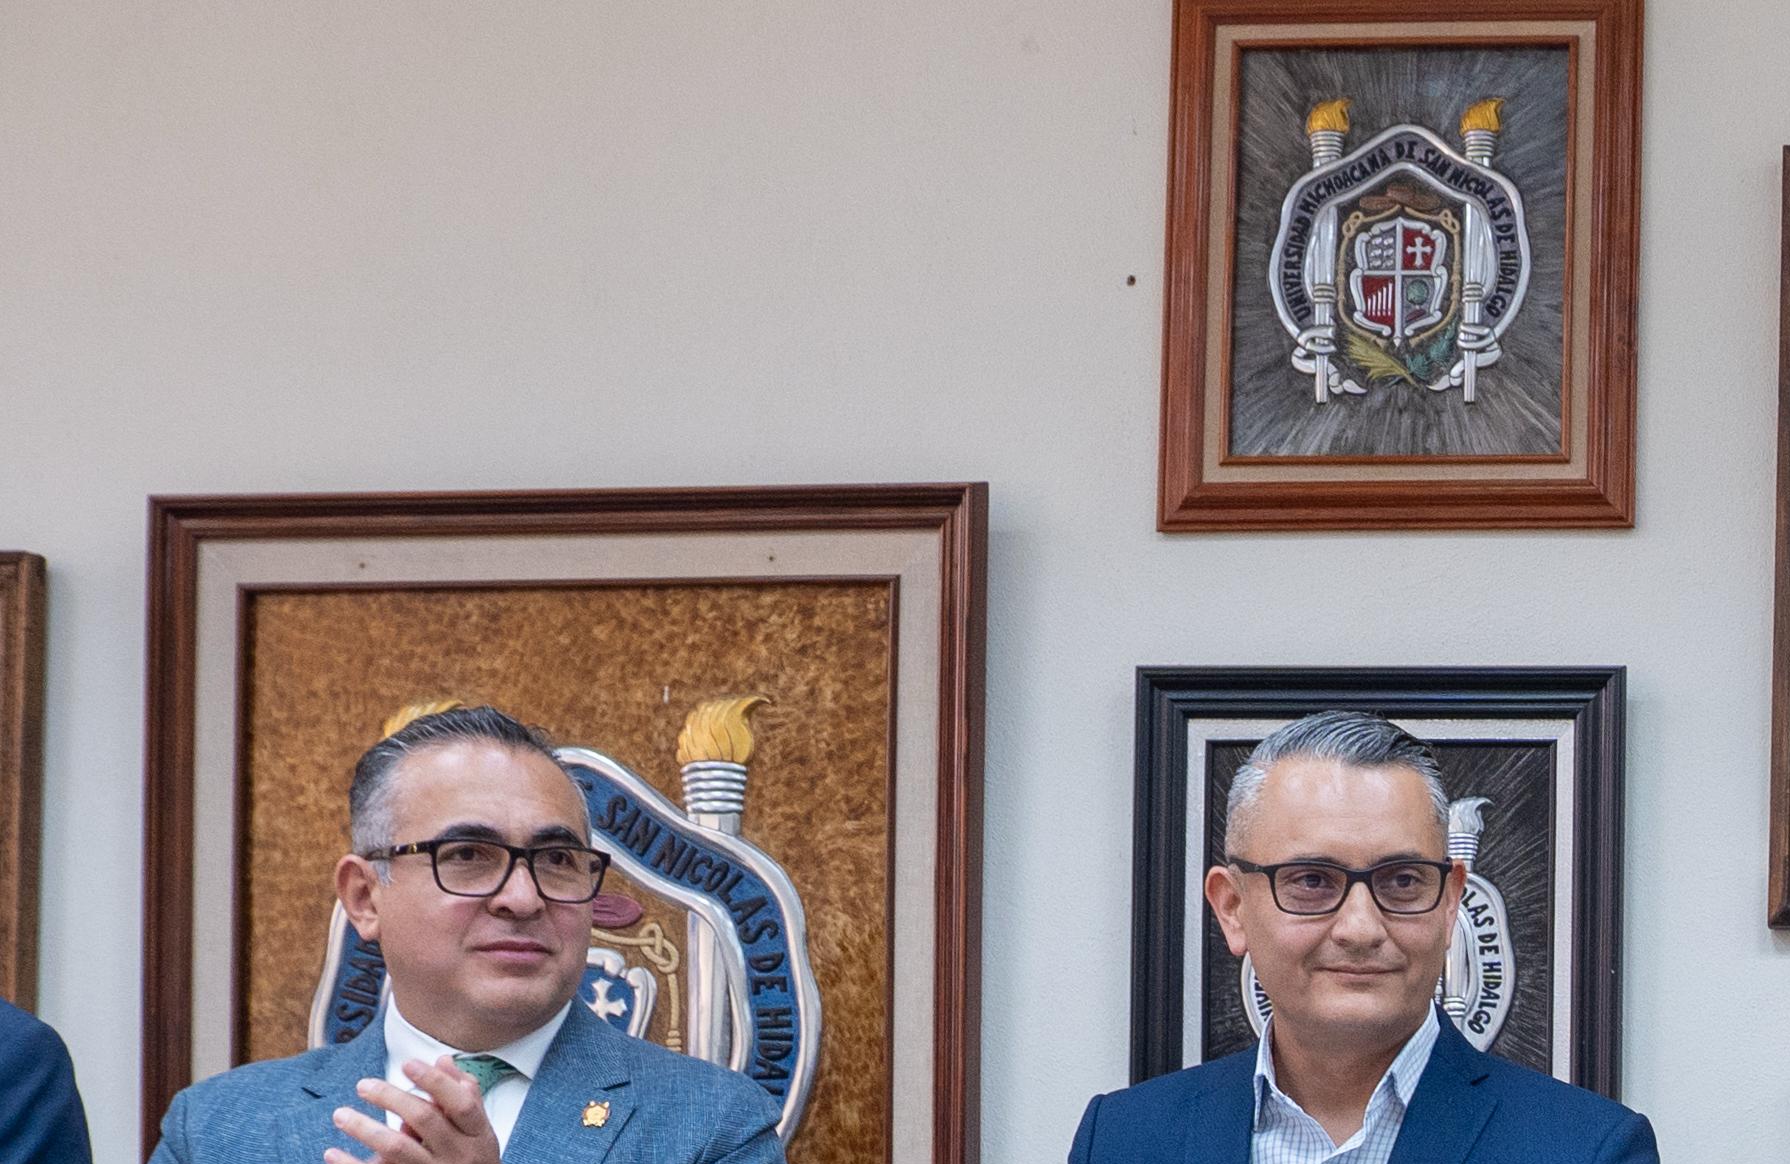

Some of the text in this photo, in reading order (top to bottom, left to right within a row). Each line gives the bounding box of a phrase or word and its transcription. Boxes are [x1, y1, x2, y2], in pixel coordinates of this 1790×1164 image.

[1300, 149, 1392, 214] MICHOACANA
[1394, 141, 1418, 161] DE
[1418, 148, 1450, 179] SAN
[1280, 212, 1312, 320] UNIVERSIDAD
[1496, 224, 1514, 245] DE
[1484, 250, 1518, 320] HIDALGO
[599, 797, 658, 866] SAN
[655, 840, 779, 947] NICOLAS
[749, 952, 788, 996] DE
[1477, 933, 1499, 955] DE
[1468, 961, 1502, 1034] HIDALGO
